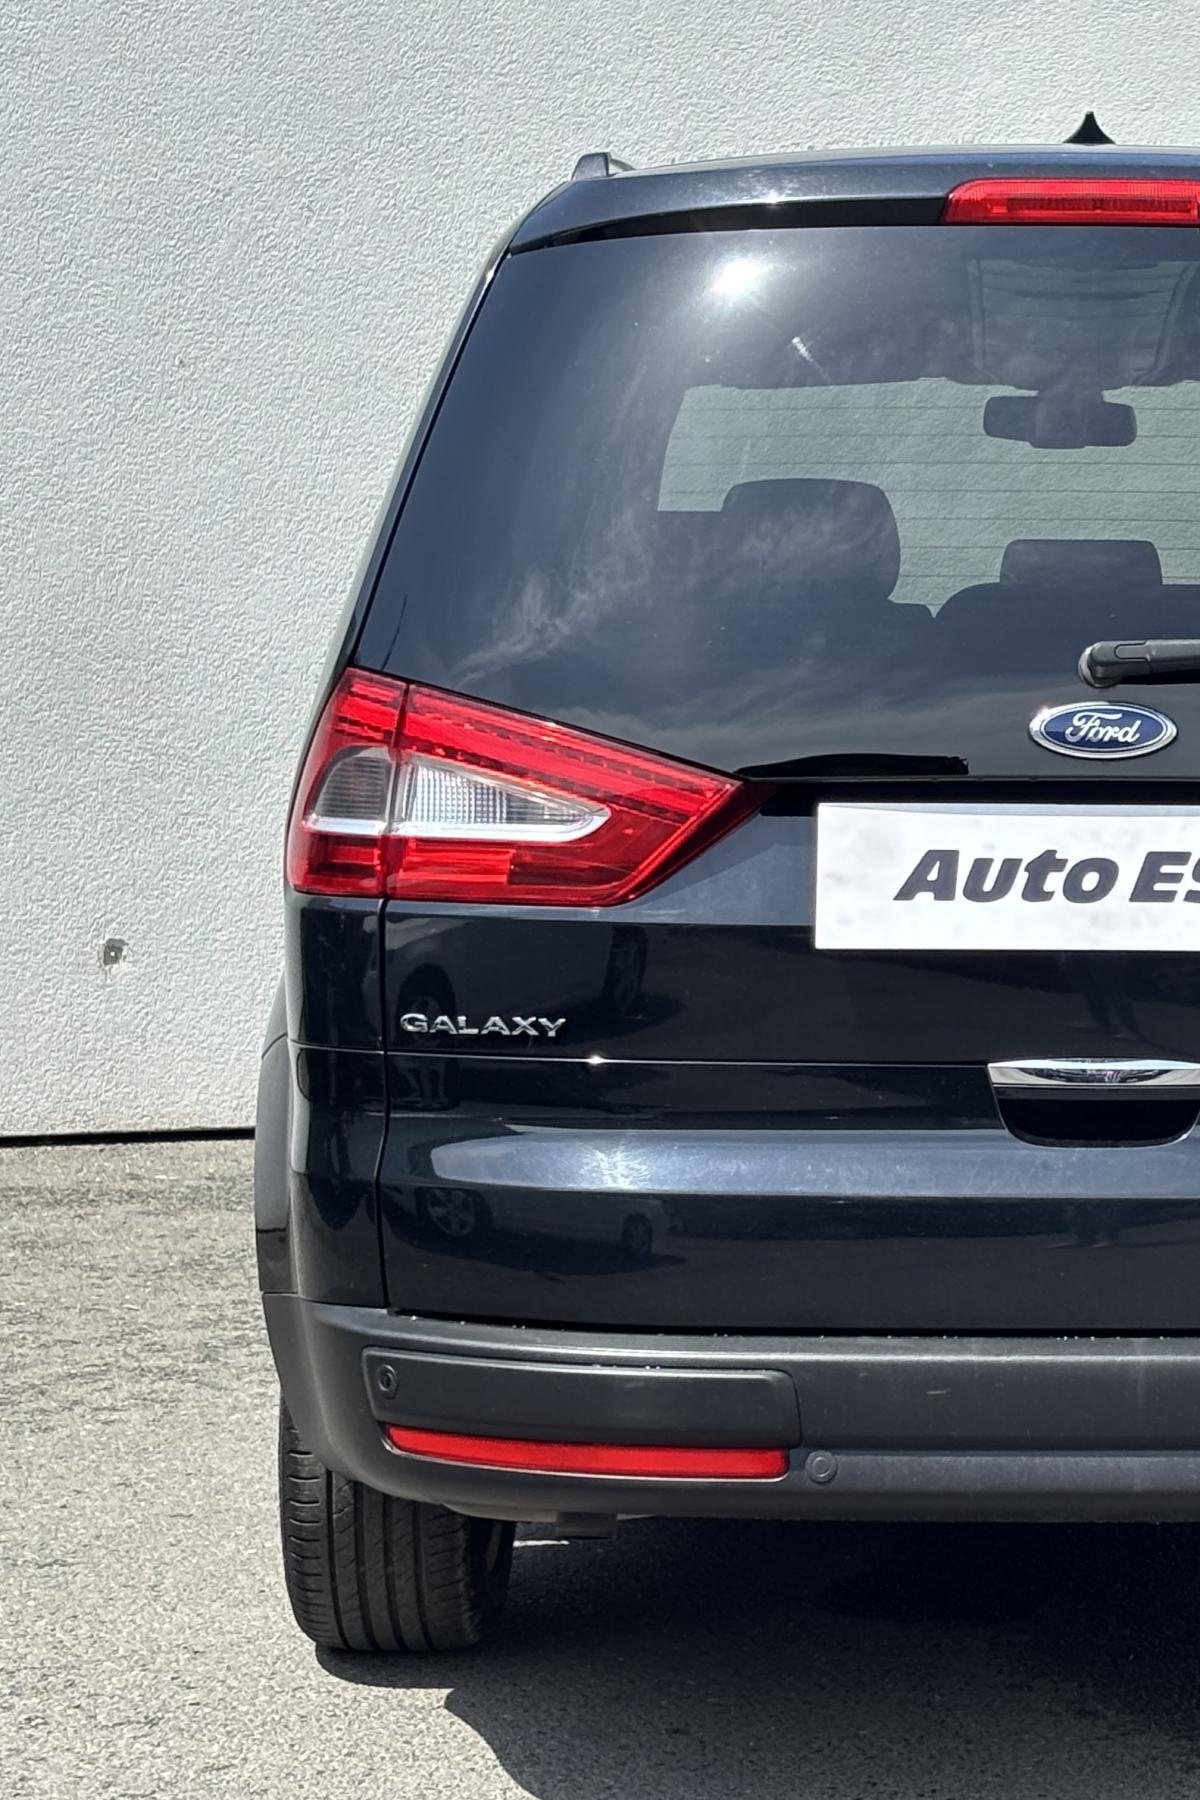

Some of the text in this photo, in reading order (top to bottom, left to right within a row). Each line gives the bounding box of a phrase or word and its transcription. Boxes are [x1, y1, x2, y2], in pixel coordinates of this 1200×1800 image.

[1065, 711, 1141, 744] Ford
[893, 849, 1120, 903] Auto
[400, 1012, 566, 1037] GALAXY
